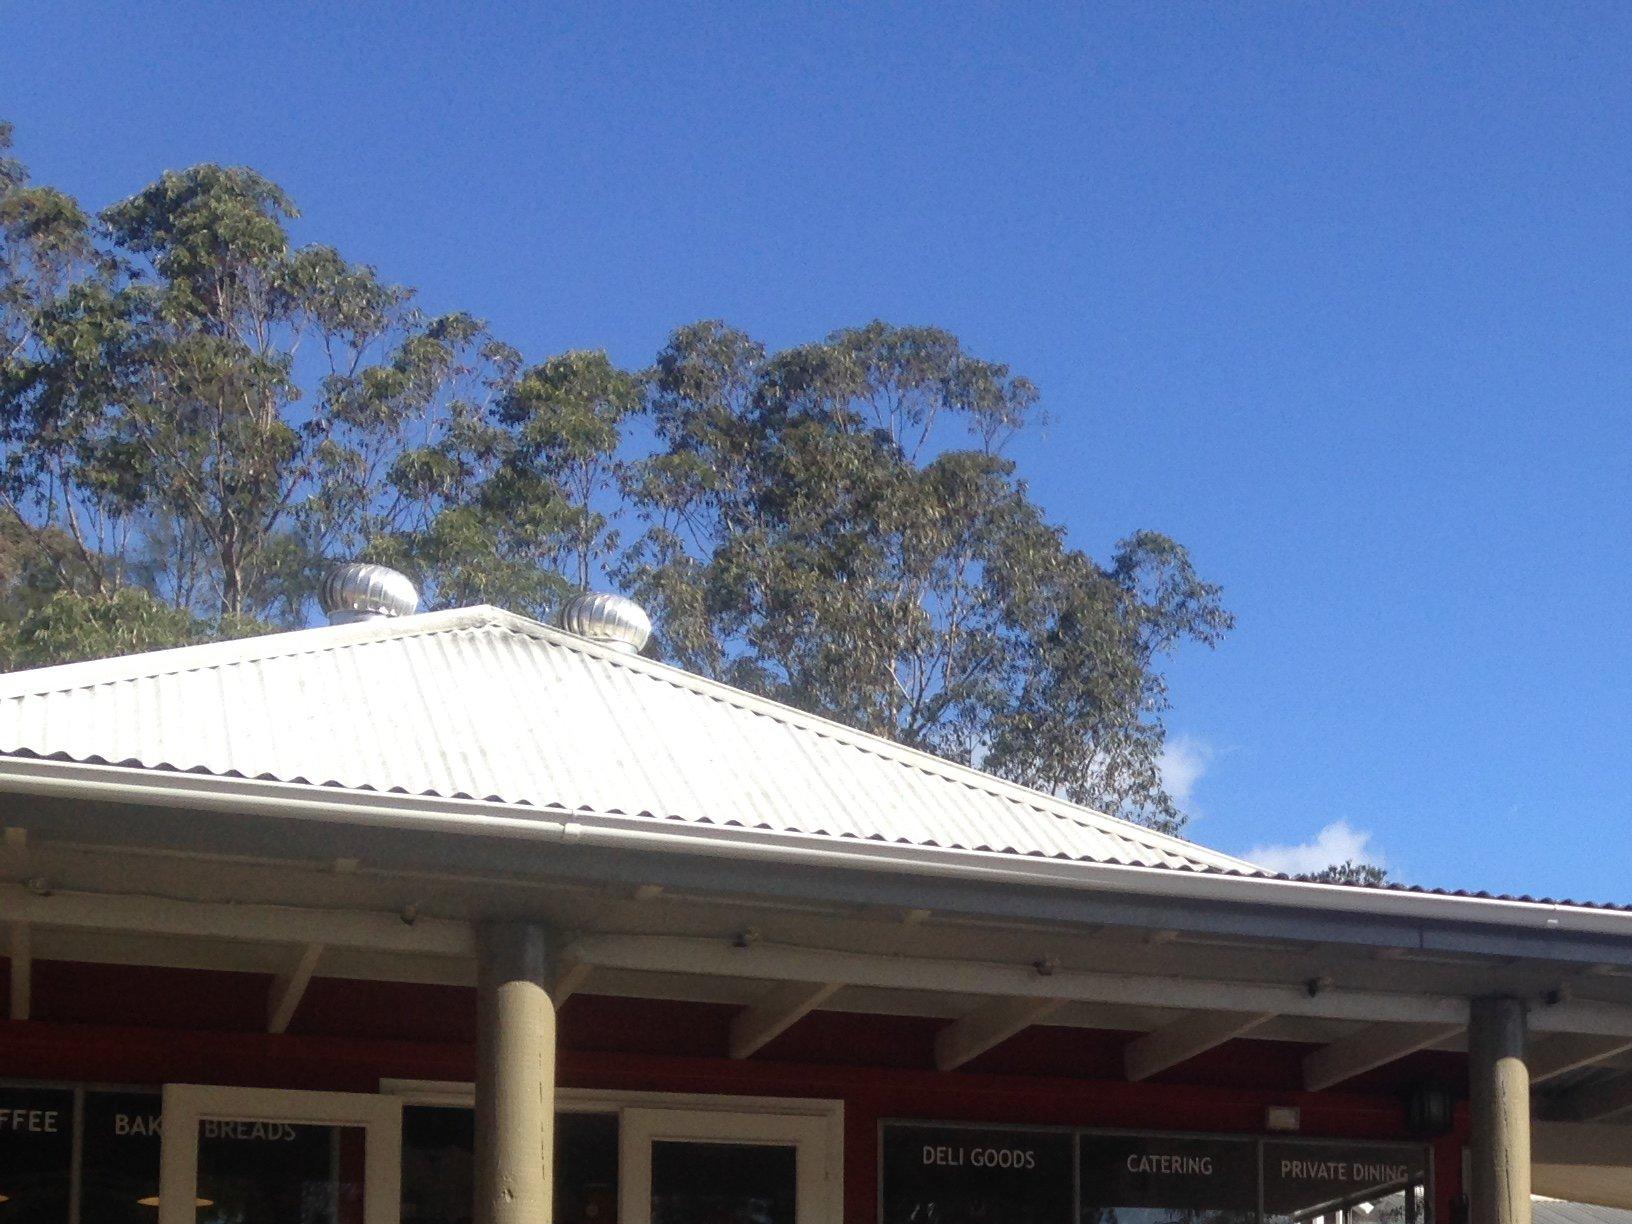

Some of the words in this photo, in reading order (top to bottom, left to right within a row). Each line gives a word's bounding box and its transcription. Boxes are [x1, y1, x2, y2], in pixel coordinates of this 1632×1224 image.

[0, 1109, 58, 1133] FFEE
[204, 1118, 297, 1142] BREADS
[922, 1146, 964, 1167] DELI
[970, 1148, 1036, 1169] GOODS
[1126, 1153, 1213, 1176] CATERING
[1280, 1160, 1348, 1180] PRIVATE
[1352, 1162, 1409, 1183] DINING
